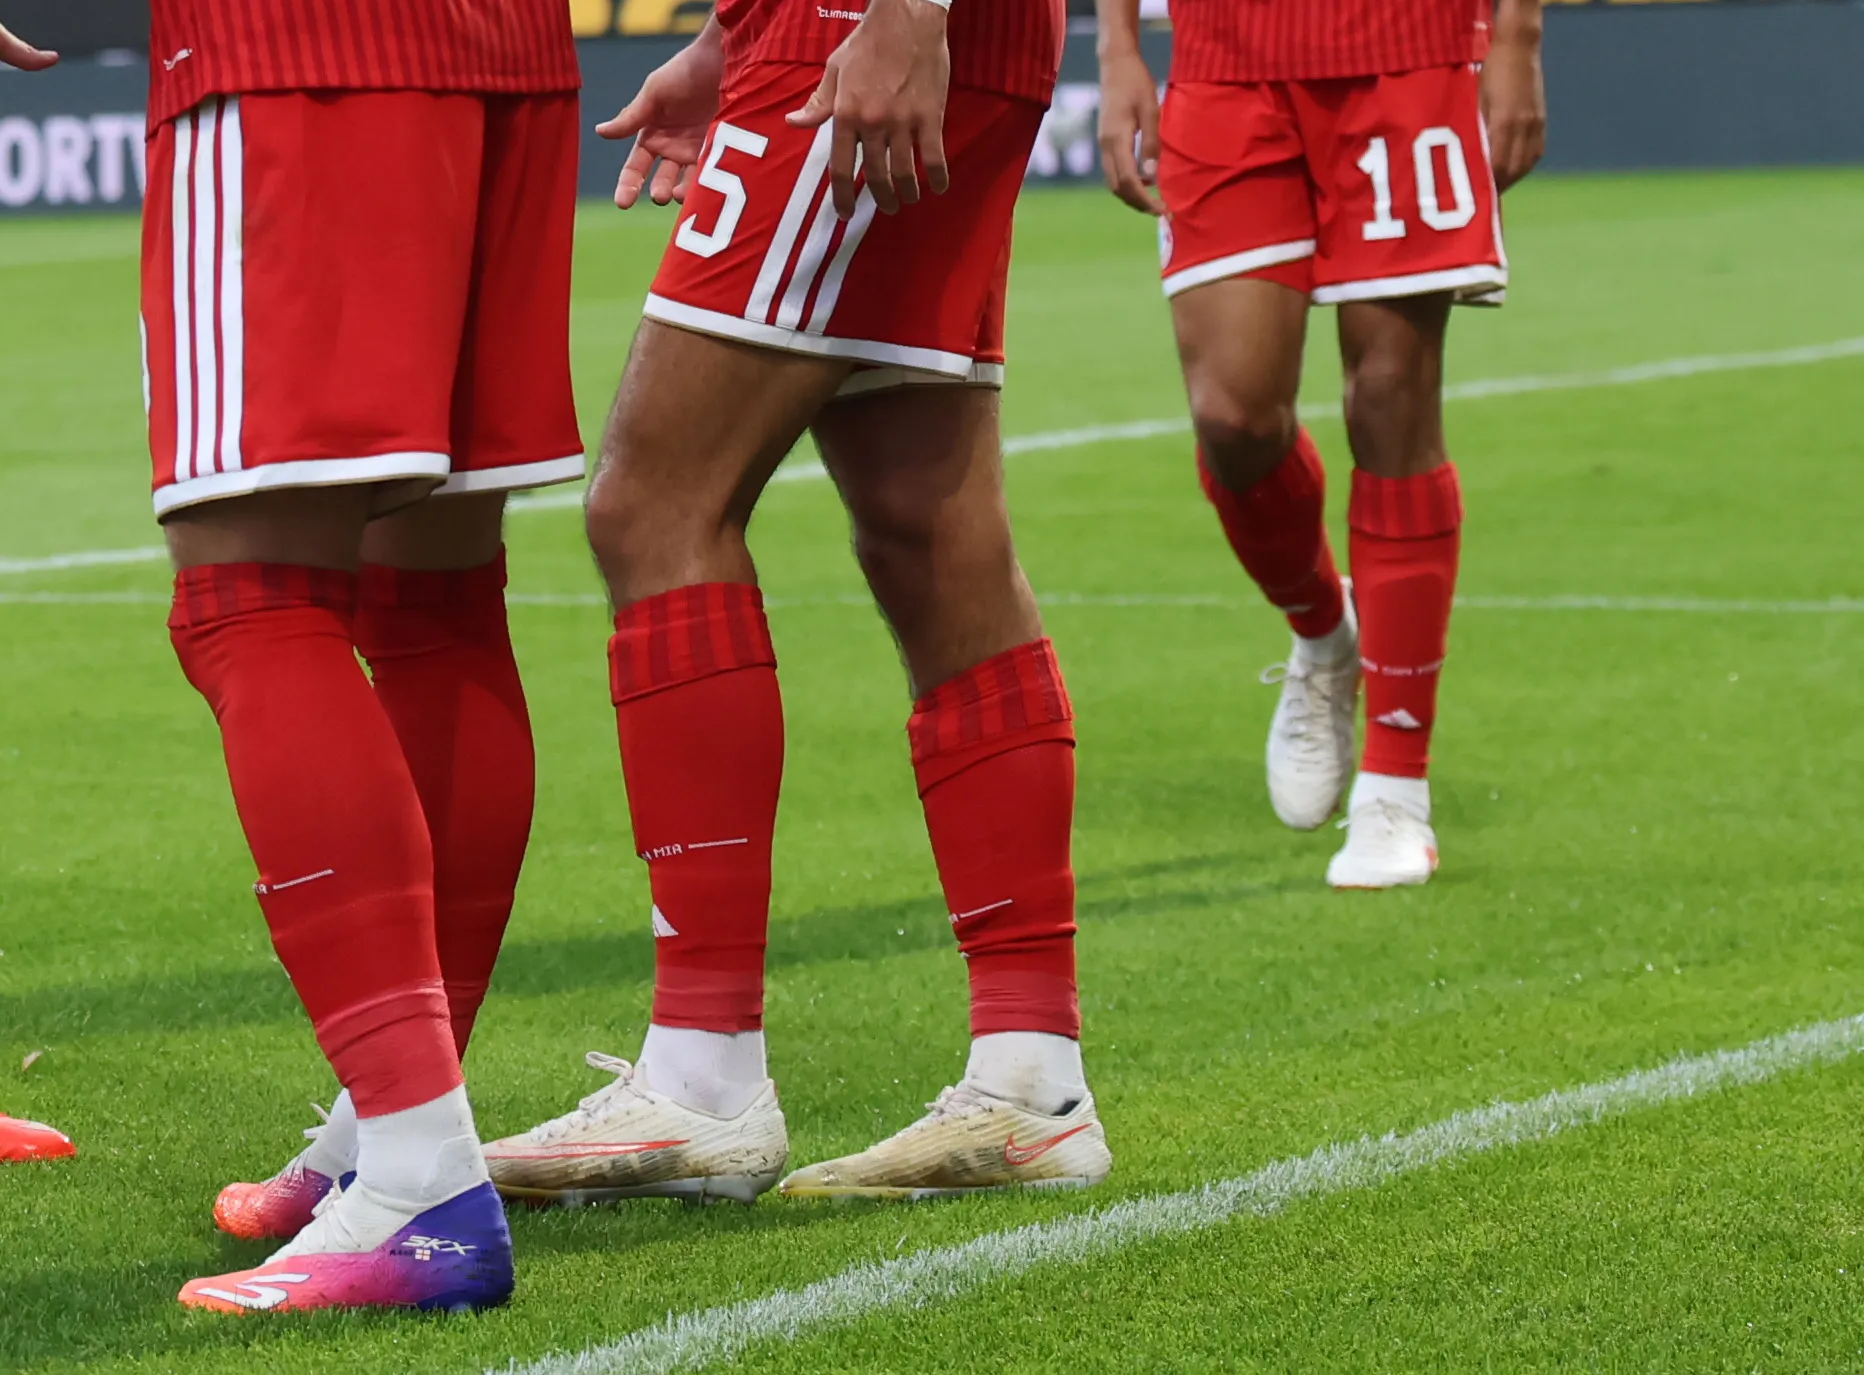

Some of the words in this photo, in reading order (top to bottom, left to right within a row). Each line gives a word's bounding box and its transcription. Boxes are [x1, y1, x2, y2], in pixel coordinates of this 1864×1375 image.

[674, 121, 770, 259] 5
[1358, 126, 1477, 241] 10
[653, 843, 683, 859] MIA
[400, 1234, 478, 1256] SKX
